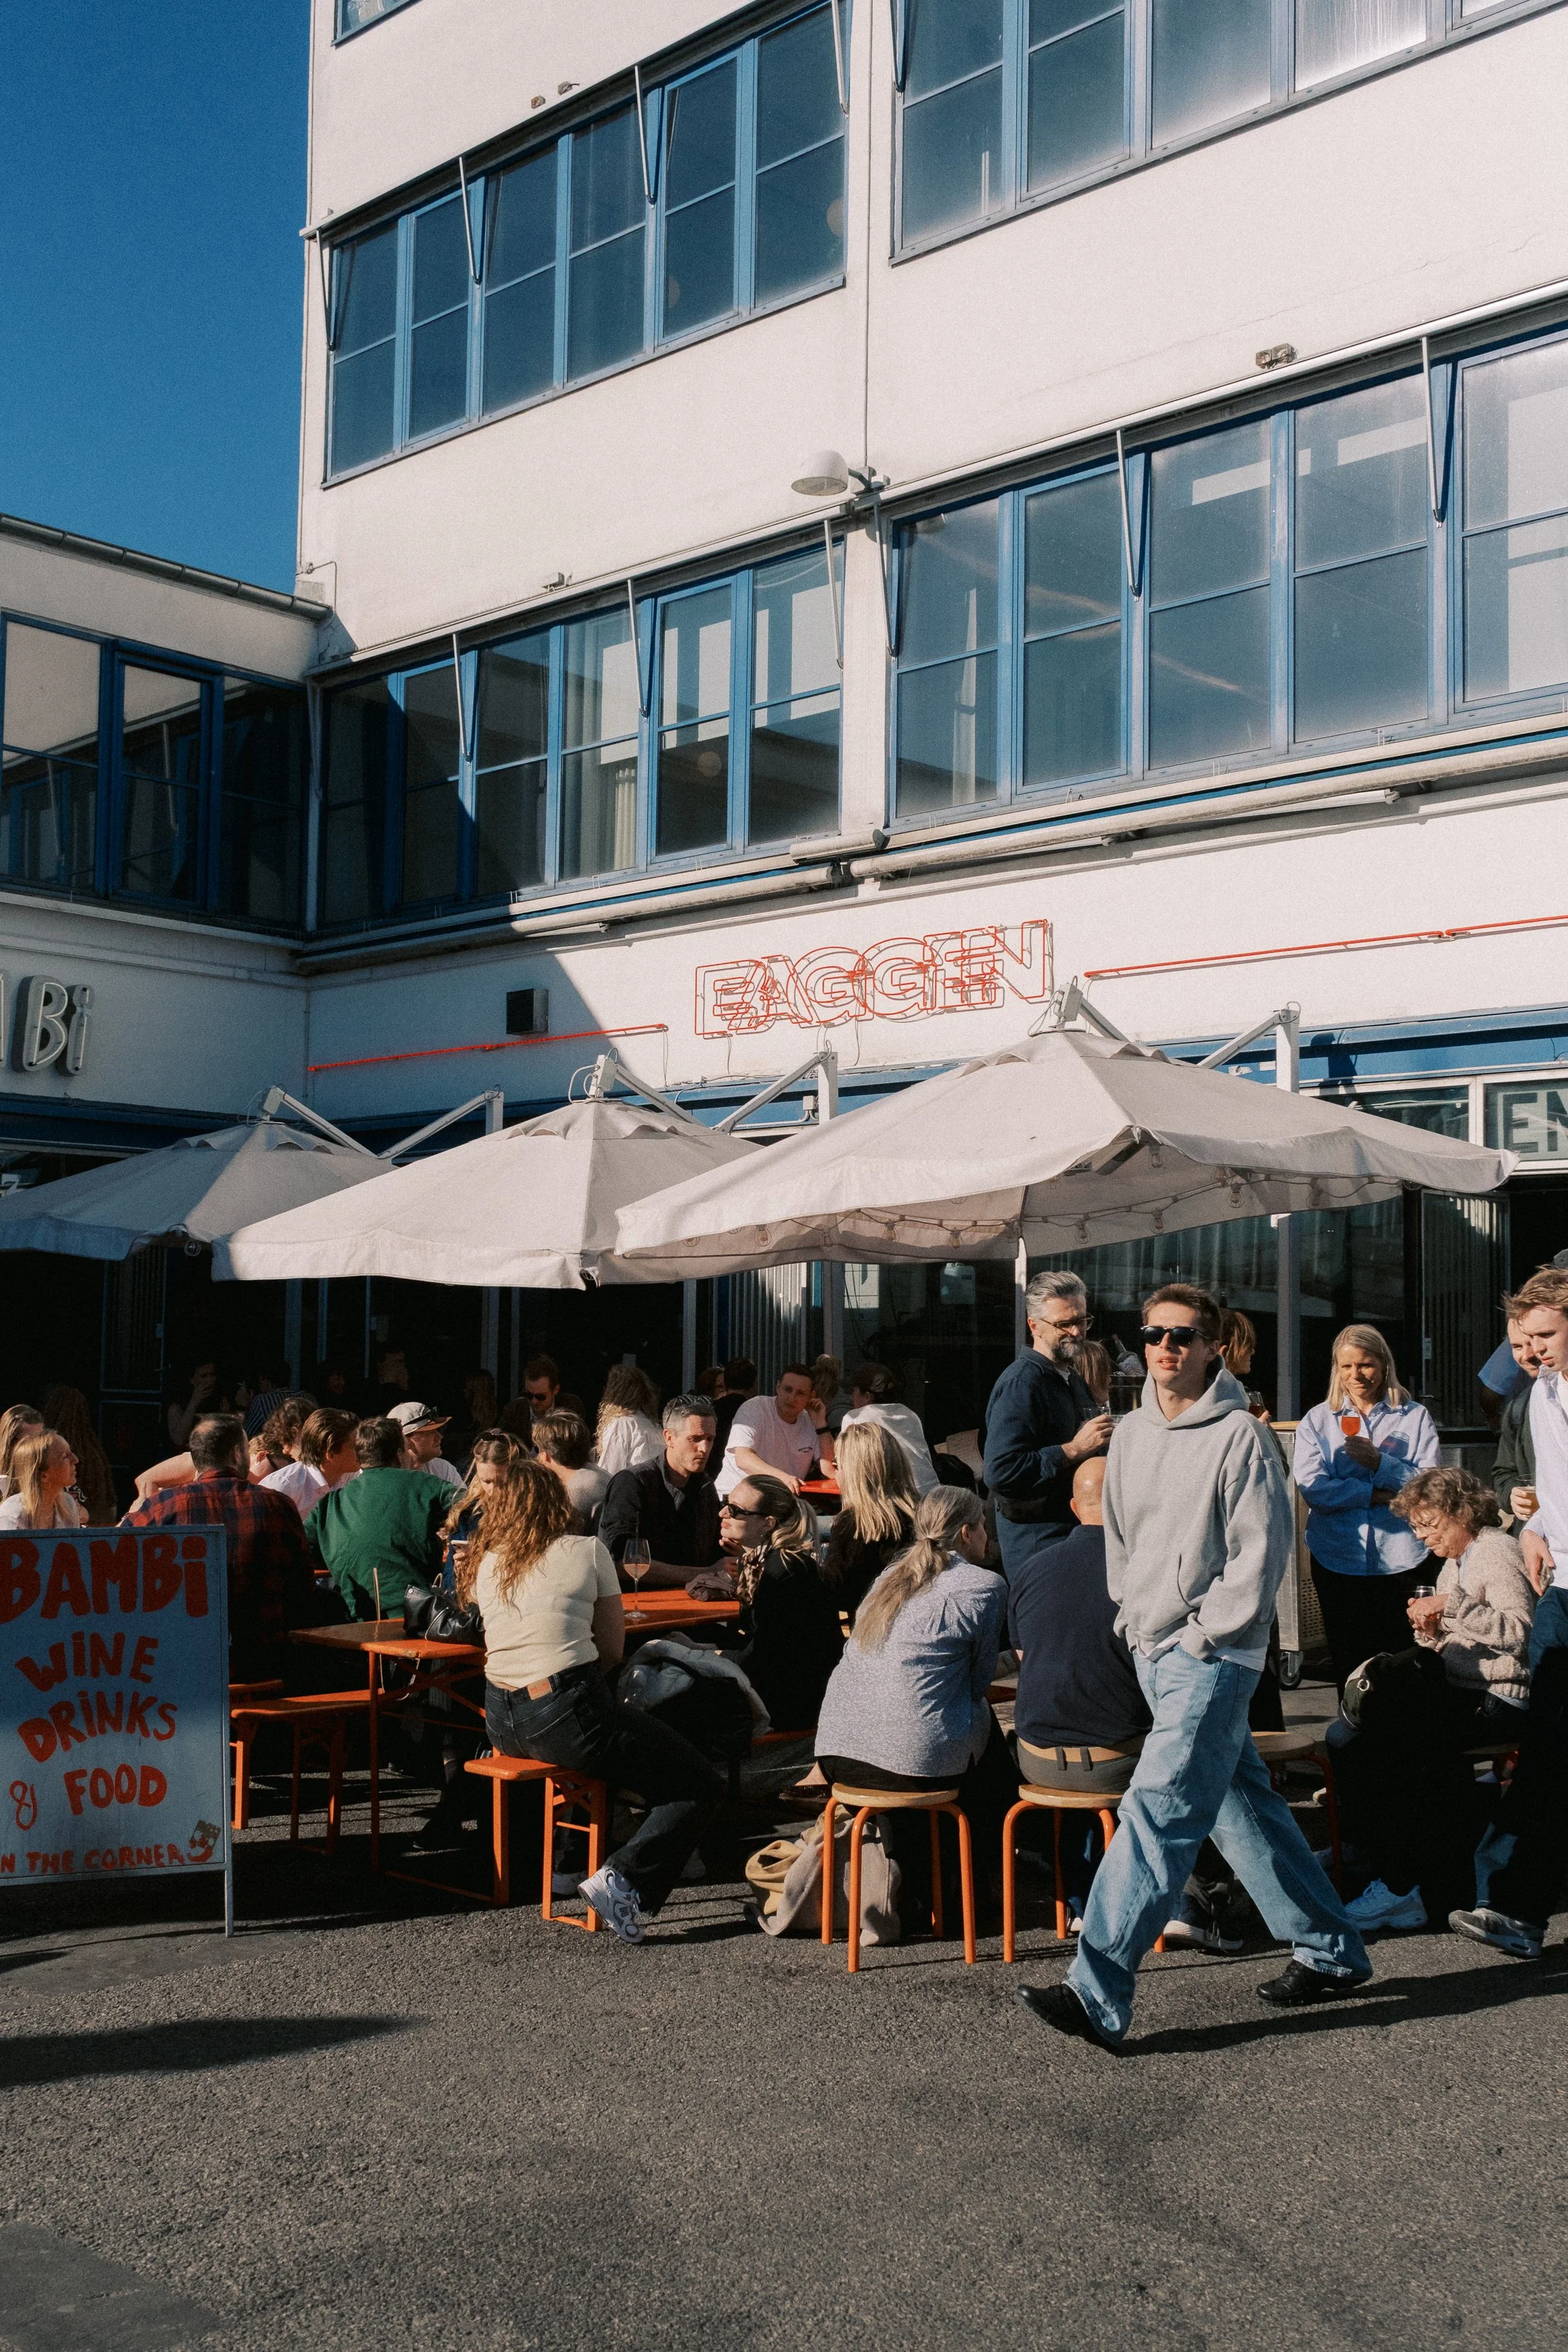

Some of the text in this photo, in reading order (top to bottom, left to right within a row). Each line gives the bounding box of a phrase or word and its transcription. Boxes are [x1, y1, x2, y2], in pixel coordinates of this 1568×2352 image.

[65, 1763, 168, 1815] FOOD
[26, 1850, 74, 1874] THE
[84, 1843, 184, 1870] CORNER
